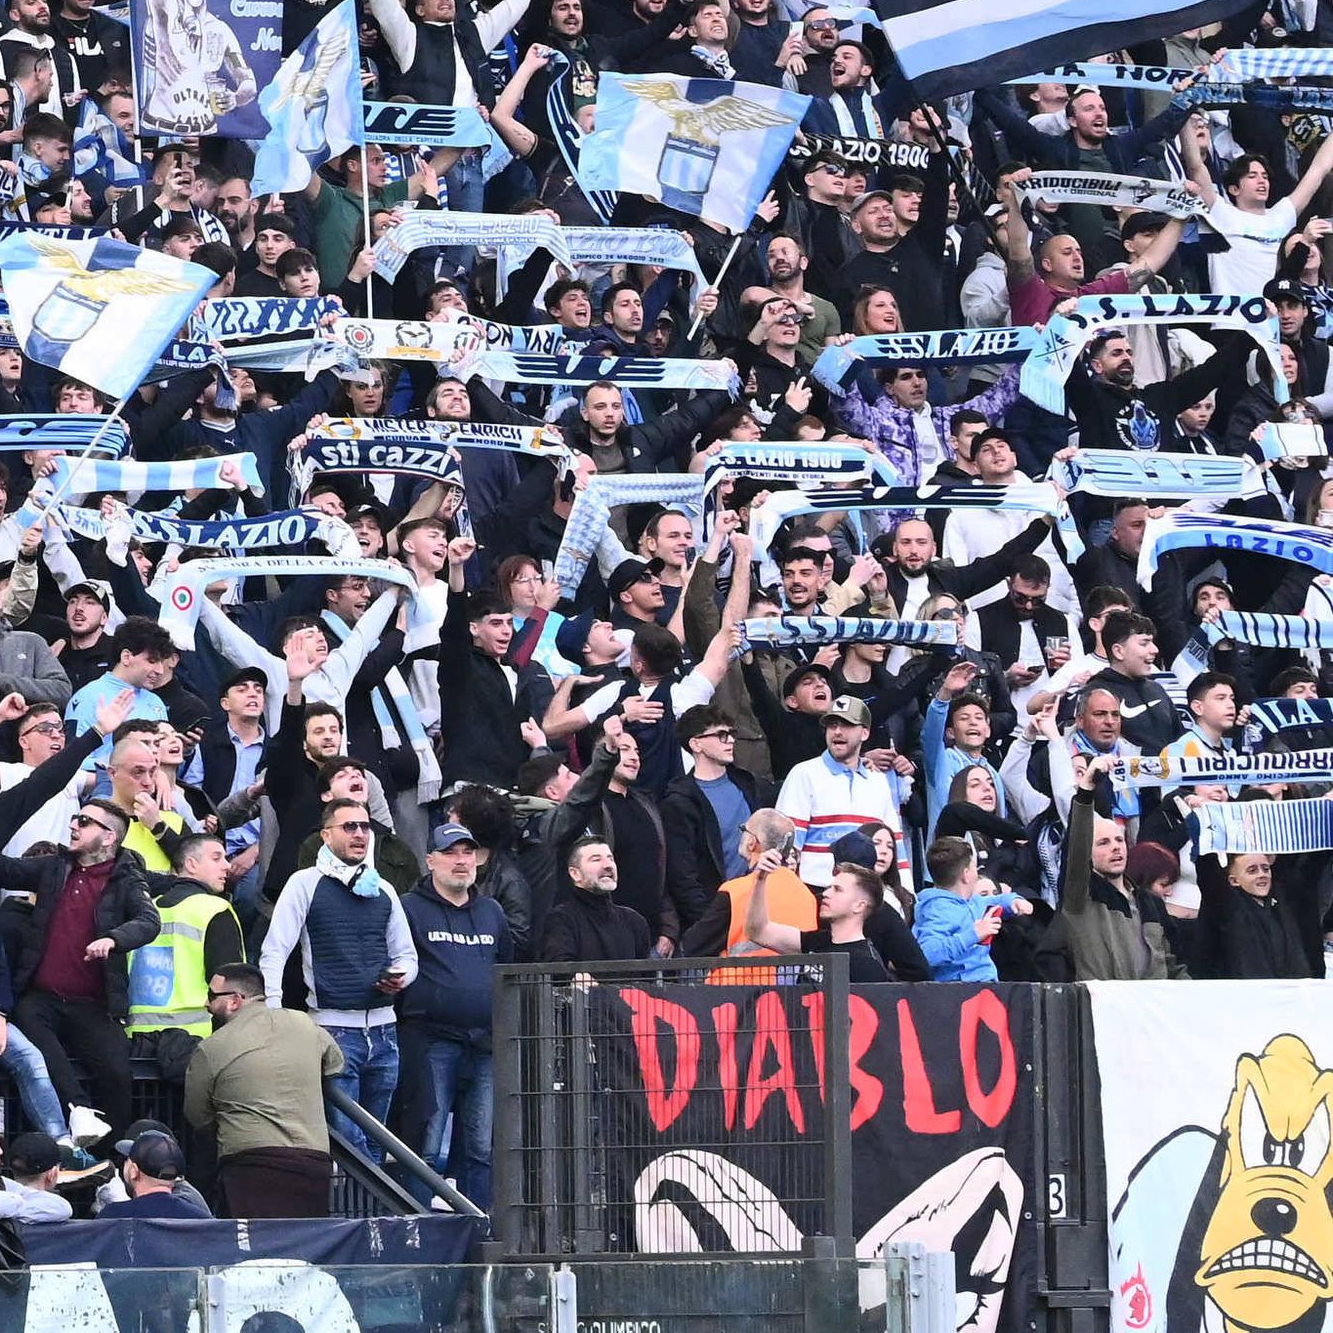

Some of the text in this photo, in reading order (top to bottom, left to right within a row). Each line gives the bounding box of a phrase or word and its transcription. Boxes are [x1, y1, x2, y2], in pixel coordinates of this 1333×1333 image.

[172, 87, 211, 109] ULTRAS
[1141, 295, 1269, 324] LAZIO
[475, 437, 503, 446] NORD
[322, 441, 452, 475] sti cazzi
[744, 452, 844, 470] LAZIO 1900
[185, 515, 311, 548] LAZIO
[1203, 532, 1314, 562] LAZIO
[267, 559, 305, 571] DELLA
[1218, 773, 1249, 781] ANNO
[619, 987, 1017, 1135] DIABLO
